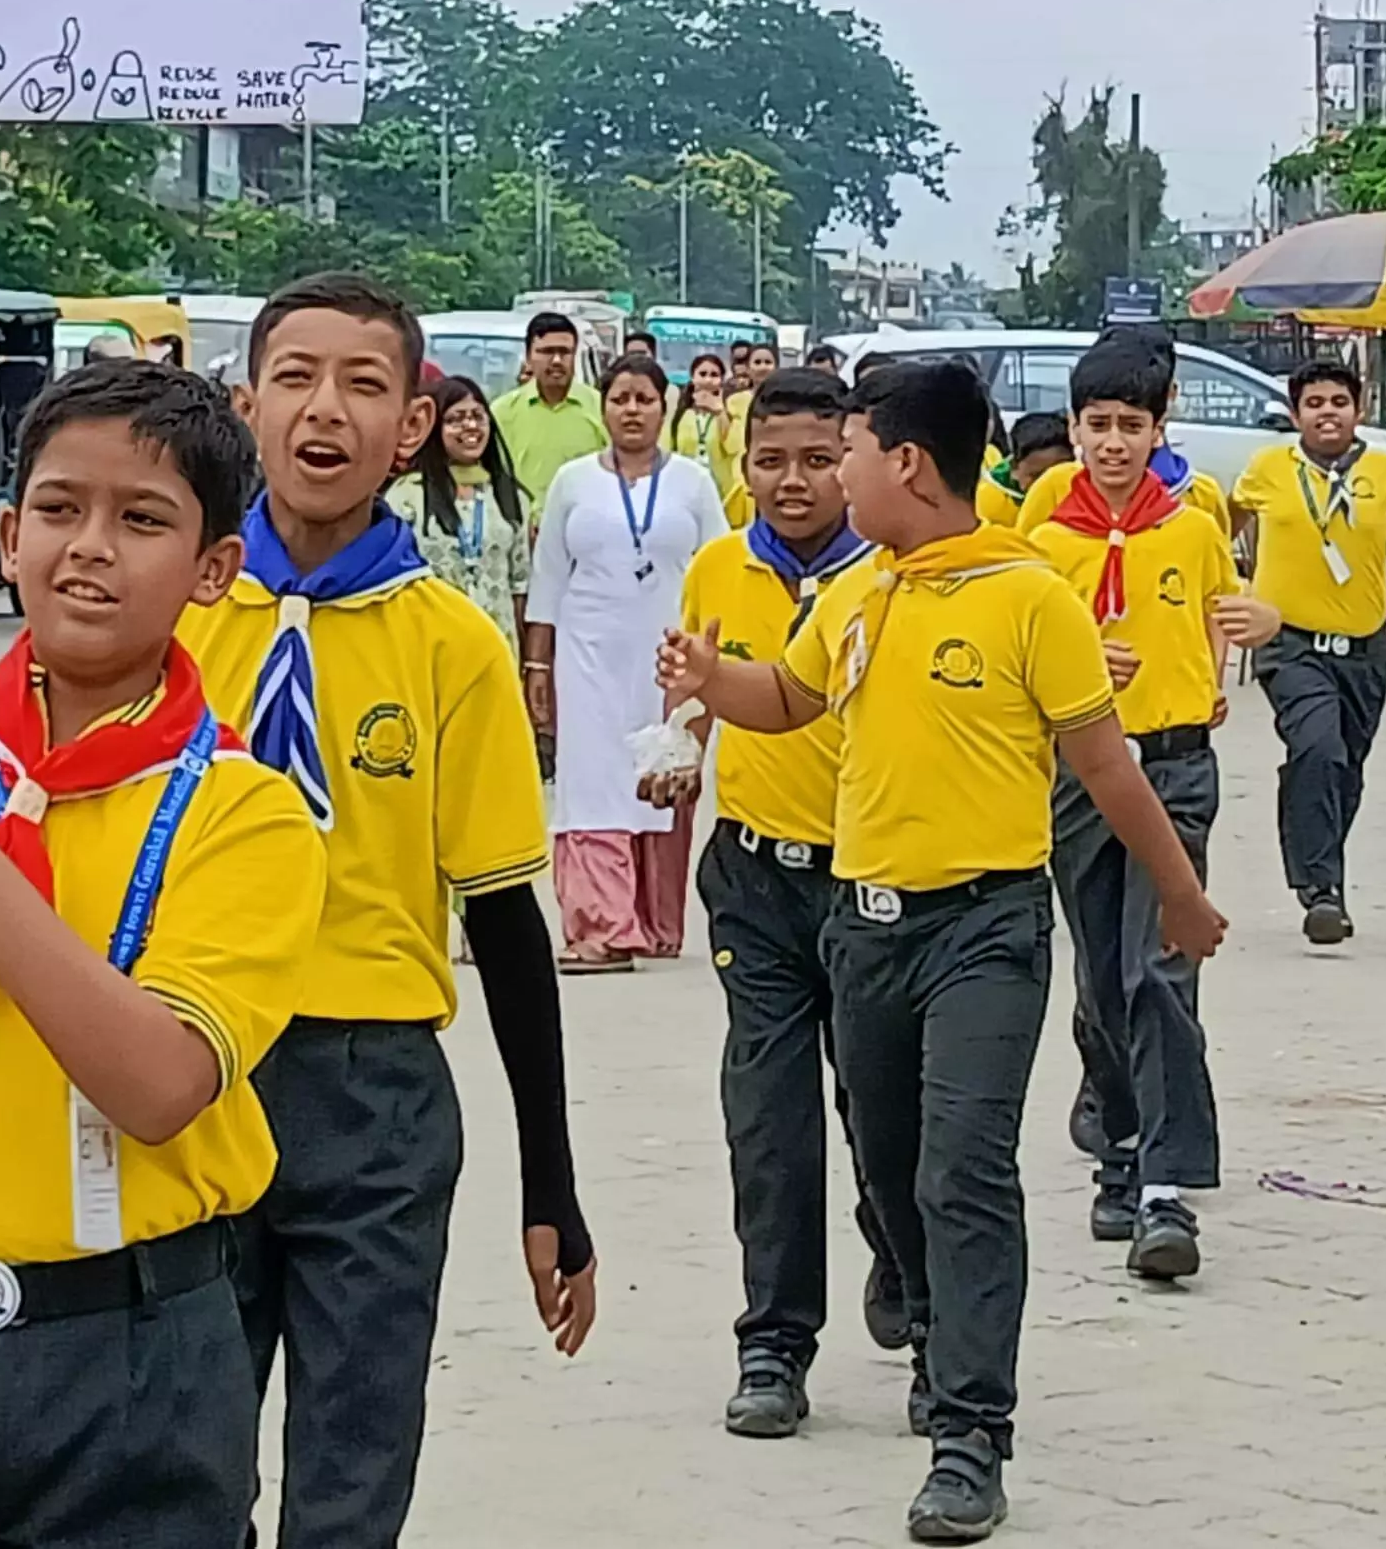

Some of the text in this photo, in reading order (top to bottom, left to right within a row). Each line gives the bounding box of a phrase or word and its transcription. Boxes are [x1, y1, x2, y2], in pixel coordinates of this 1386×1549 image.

[160, 65, 217, 82] REUSE
[236, 70, 287, 87] SAVE
[159, 87, 221, 100] REDUCE
[236, 91, 292, 108] WATER
